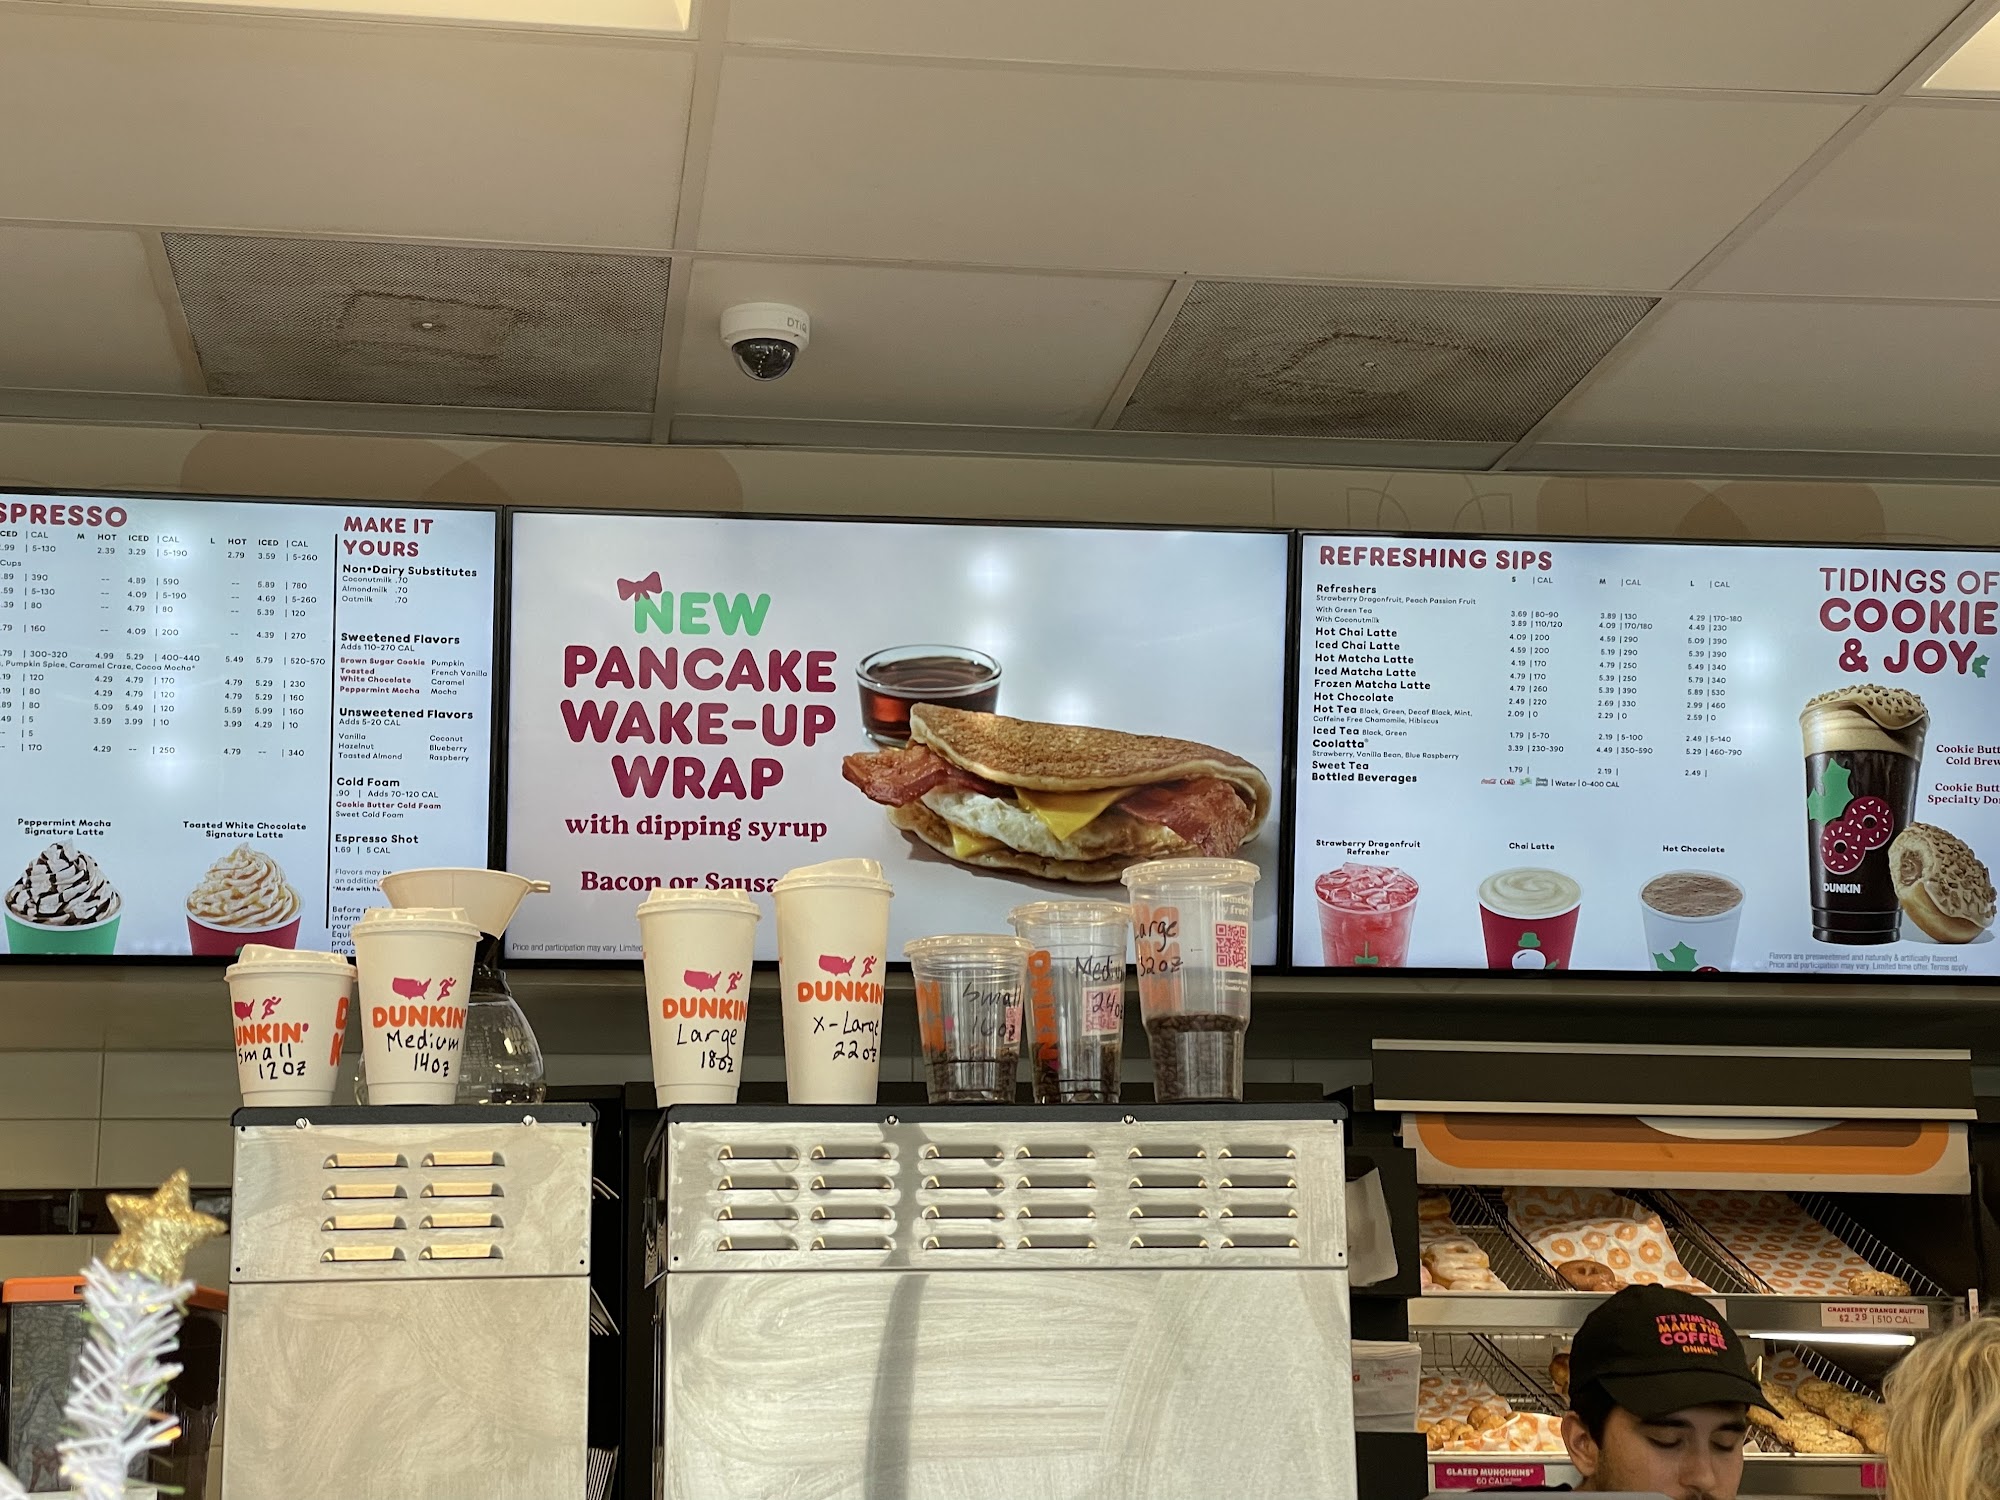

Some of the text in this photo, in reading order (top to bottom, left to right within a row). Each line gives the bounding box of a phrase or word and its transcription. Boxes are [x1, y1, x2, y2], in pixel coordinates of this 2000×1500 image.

[343, 516, 433, 534] MAKE IT
[343, 540, 419, 557] YOURS
[1320, 546, 1552, 570] REFRESHING SIPS
[408, 567, 477, 577] Substitutes
[1819, 567, 2000, 594] TIDINGS OF
[1317, 584, 1376, 593] Refreshers
[1316, 595, 1357, 603] Strawberry
[634, 591, 771, 636] NEW
[1819, 598, 1999, 635] COOKIE
[1316, 628, 1336, 636] Hot
[1367, 629, 1397, 637] Latte
[341, 633, 460, 644] Sweetened Flavors
[1316, 641, 1338, 649] Iced
[1370, 642, 1400, 650] Latte
[1315, 654, 1413, 664] Hot Matcha Latte
[1839, 638, 1978, 674] & JOY
[370, 658, 393, 666] Sugar
[431, 660, 464, 668] Pumpkin
[564, 645, 837, 693] PANCAKE
[1314, 680, 1430, 690] Frozen Matcha Latte
[340, 686, 389, 695] Peppermint
[1314, 693, 1393, 702] Hot Chocolate
[255, 707, 273, 715] 5.99
[340, 708, 473, 719] Unsweetened Flavors
[560, 700, 836, 747] WAKE-UP
[1936, 745, 1974, 753] Cookie
[1312, 762, 1369, 770] Sweet Tea
[1946, 757, 2000, 765] Cold Brew
[337, 777, 400, 787] Cold Foam
[611, 755, 784, 800] WRAP
[1312, 773, 1417, 784] Bottled Beverages
[1935, 783, 1972, 791] Cookie
[1928, 795, 1980, 805] Specialty
[18, 818, 76, 828] Peppermint
[183, 821, 306, 830] Toasted White Chocolate
[24, 828, 73, 837] Signature
[565, 815, 827, 842] with dipping syrup
[206, 831, 283, 839] Signature Latte
[335, 834, 418, 844] Espresso Shot
[1315, 839, 1421, 849] Strawberry Dragonfruit
[1509, 842, 1528, 850] Chai
[1662, 845, 1725, 853] Hot Chocolate
[1347, 848, 1390, 856] Refresher
[581, 871, 779, 892] Bacon or Sausa
[387, 1030, 459, 1052] Medium
[677, 1024, 737, 1059] Large
[1895, 1316, 1914, 1324] CAL
[1659, 1322, 1723, 1337] MAKE THE
[1660, 1332, 1727, 1350] COFFEE
[1447, 1468, 1478, 1476] GLAZED
